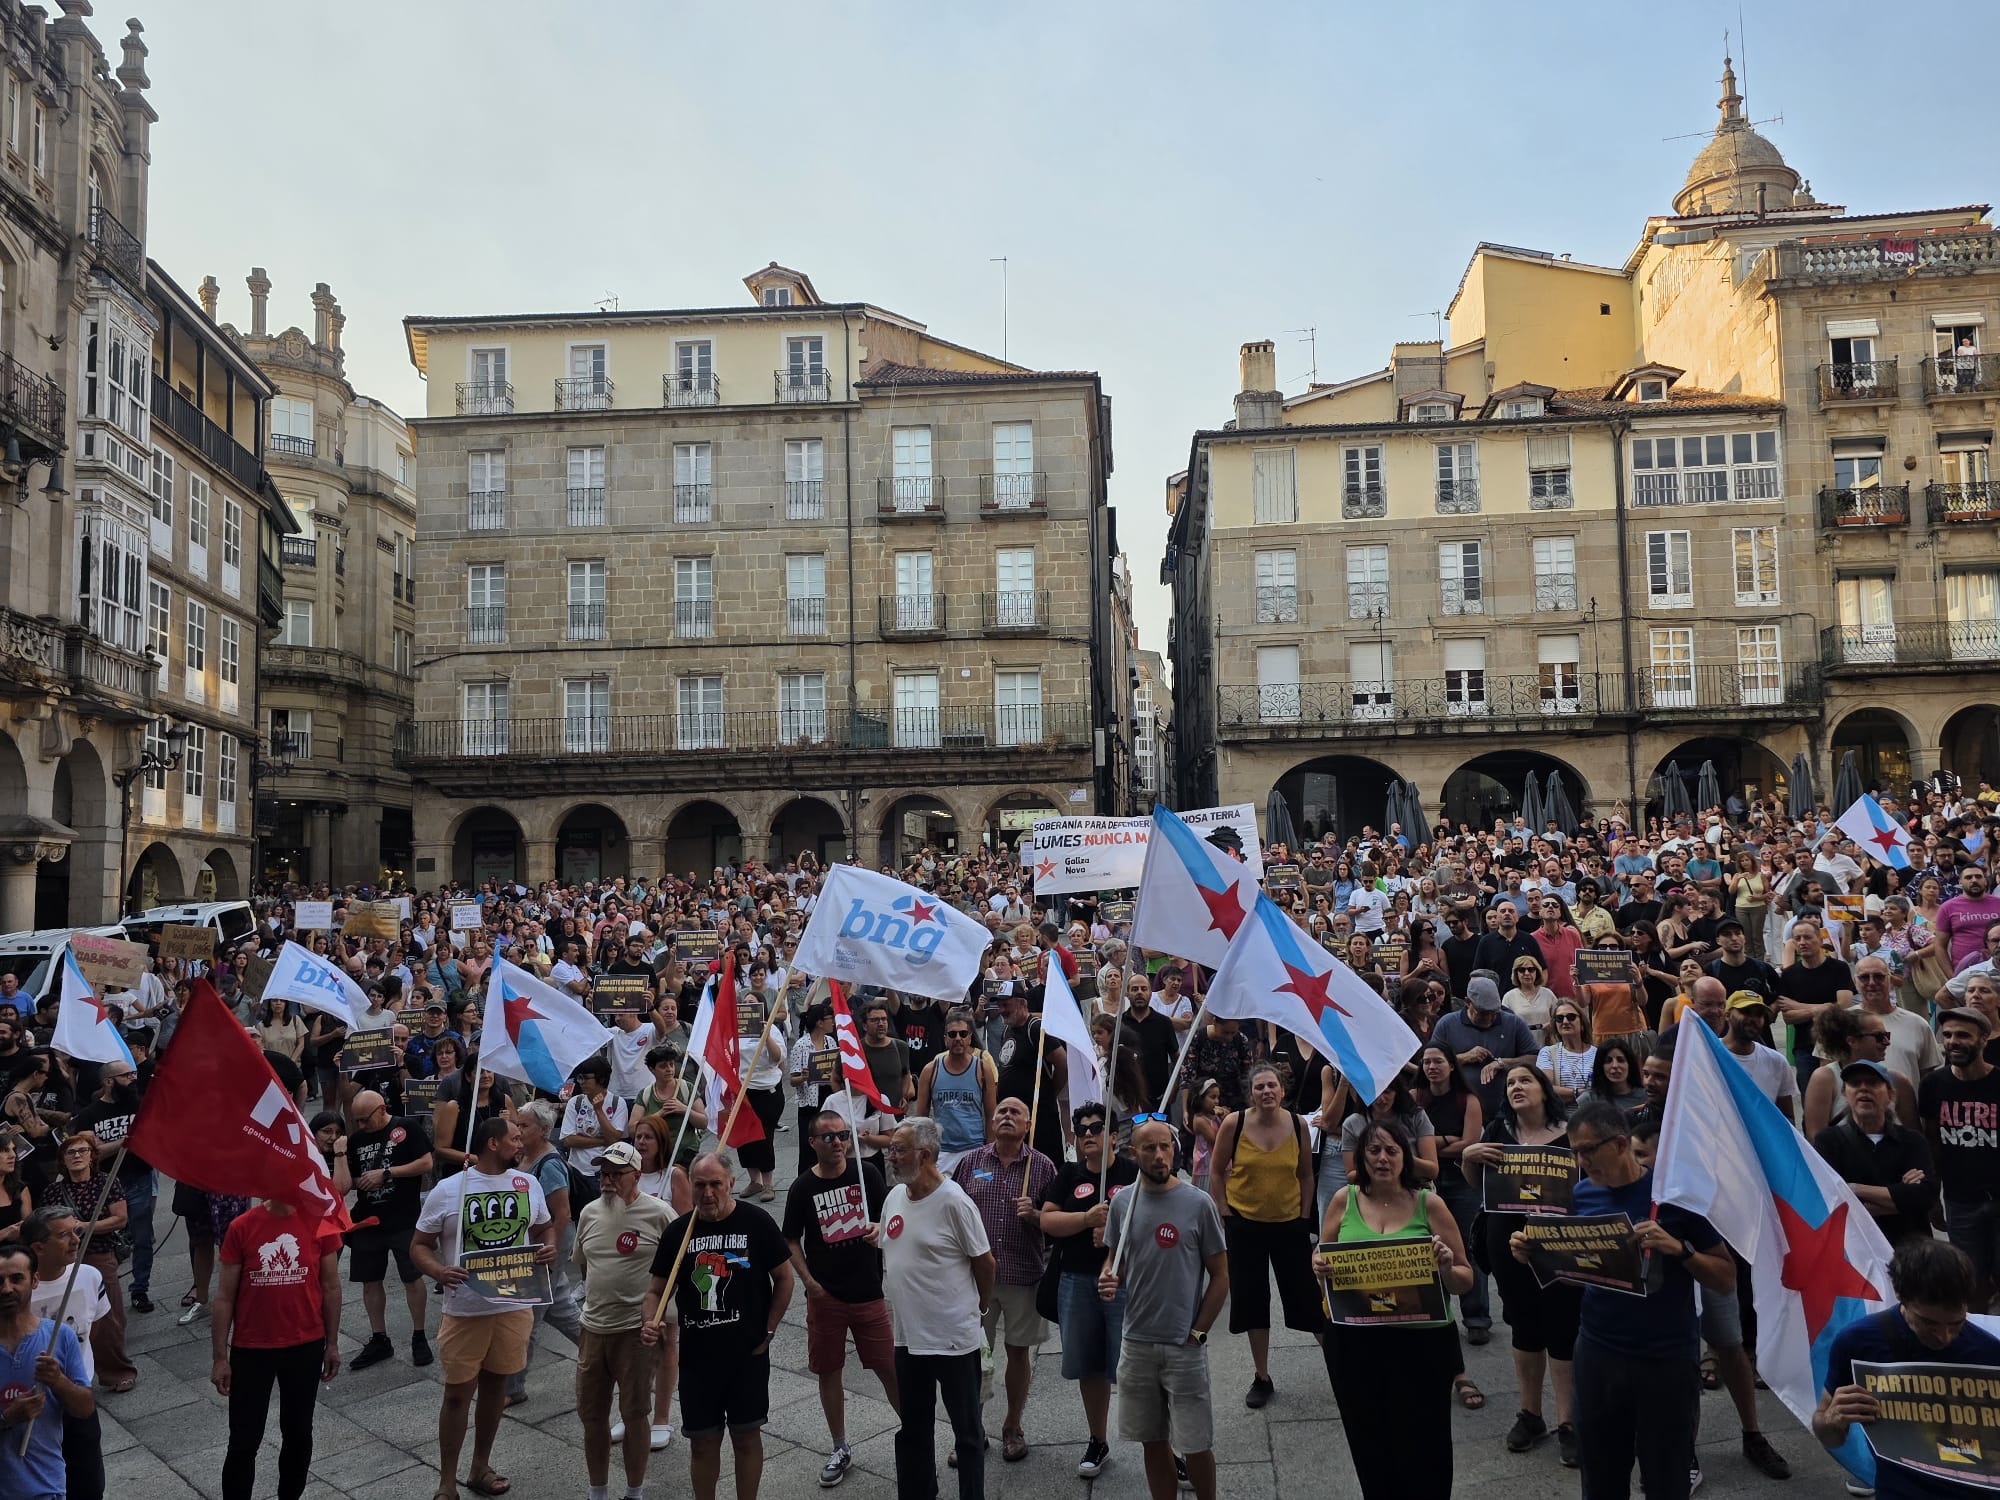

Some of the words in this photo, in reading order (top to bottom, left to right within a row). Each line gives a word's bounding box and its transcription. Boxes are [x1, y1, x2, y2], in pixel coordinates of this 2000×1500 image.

[1885, 252, 1914, 262] NON
[1034, 820, 1083, 832] SOBERANÍA
[1085, 820, 1107, 830] PARA
[1108, 820, 1150, 829] DEFENDER
[1182, 814, 1208, 825] NOSA
[1210, 810, 1240, 821] TERRA
[1034, 835, 1081, 850] LUMES
[1084, 832, 1132, 846] NUNCA
[1065, 857, 1090, 865] Galiza
[1065, 866, 1086, 874] Nova
[840, 898, 945, 965] bng
[1940, 1100, 1997, 1128] ALTRI
[1940, 1125, 1997, 1147] NON
[1500, 1153, 1540, 1163] UCALIPTO
[1547, 1154, 1577, 1168] PRAGA
[1510, 1166, 1521, 1174] PP
[1522, 1165, 1545, 1176] DALLE
[1546, 1167, 1568, 1178] ALAS
[1560, 1222, 1628, 1238] FORESTAIS
[687, 1235, 723, 1254] ALESTINA
[1541, 1241, 1586, 1250] NUNCA
[1587, 1239, 1619, 1250] MÁIS
[465, 1256, 495, 1270] LUMES
[496, 1252, 537, 1265] FORESTA
[1332, 1252, 1366, 1264] POLÍTICA
[1368, 1248, 1405, 1260] FORESTAL
[1407, 1247, 1418, 1256] DO
[1420, 1246, 1431, 1255] PP
[477, 1269, 509, 1281] NUNCA
[509, 1266, 534, 1280] MÁIS
[1333, 1266, 1356, 1276] UEIMA
[1358, 1264, 1369, 1273] OS
[1371, 1261, 1397, 1272] NOSOS
[1399, 1257, 1434, 1269] MONTES,
[1334, 1275, 1363, 1287] QUEIMA
[1366, 1274, 1376, 1283] AS
[1377, 1271, 1403, 1281] NOSAS
[1404, 1269, 1431, 1280] CASAS
[696, 1308, 741, 1328] فلسطين
[1865, 1374, 1946, 1396] PARTIDO
[1950, 1377, 2000, 1400] POPU
[1877, 1399, 1945, 1424] NIMIGO
[1951, 1404, 1977, 1426] DO
